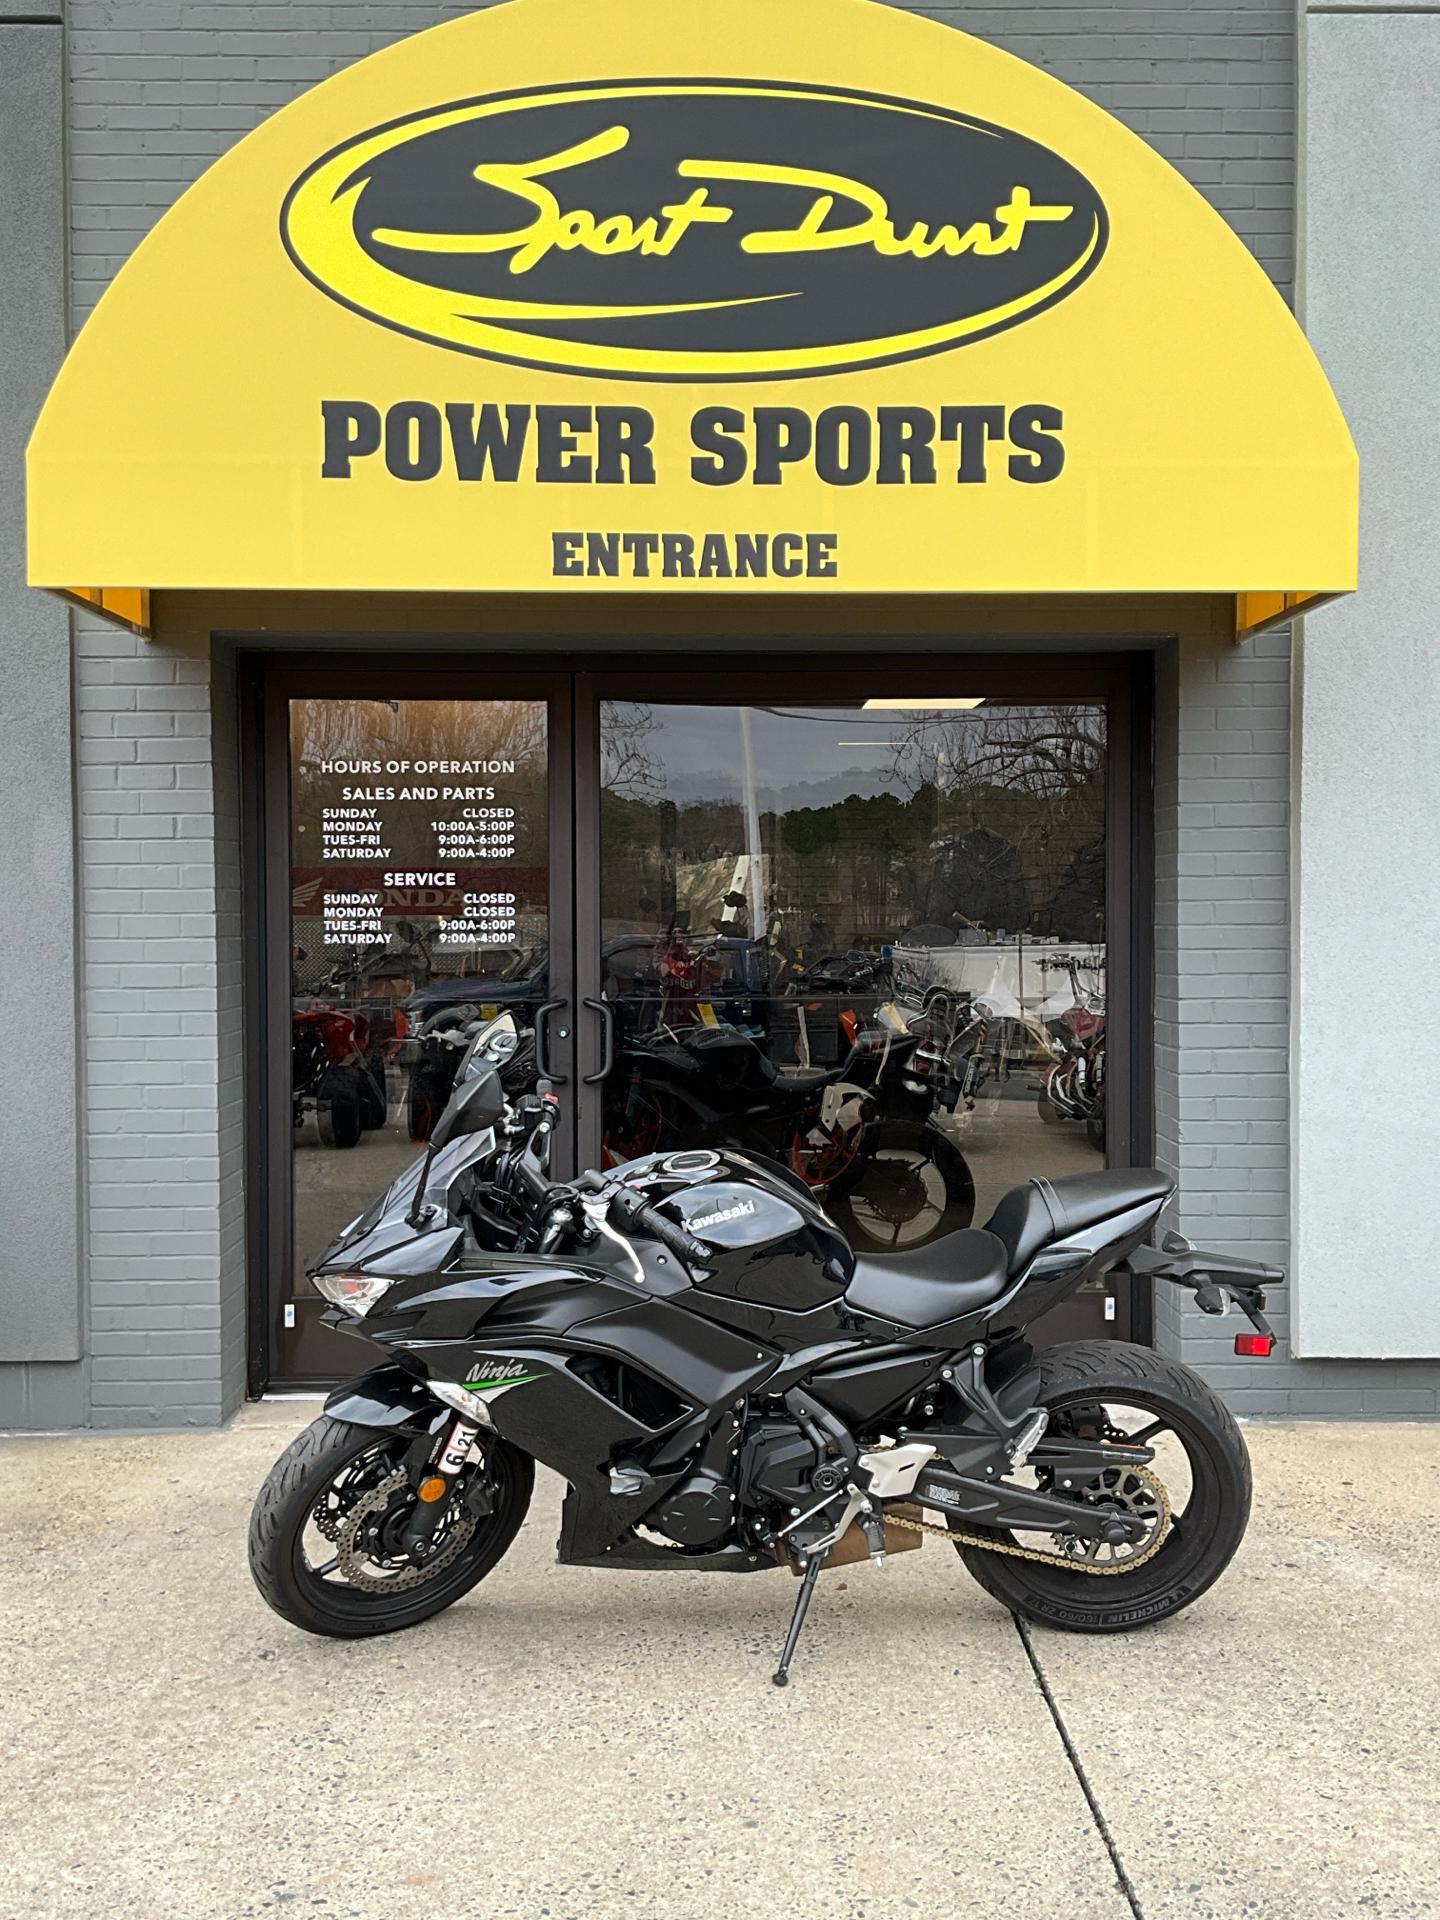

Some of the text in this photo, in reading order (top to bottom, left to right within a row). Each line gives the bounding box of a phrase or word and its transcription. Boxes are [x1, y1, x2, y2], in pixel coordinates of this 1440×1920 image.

[321, 401, 1065, 487] POWER SPORTS
[552, 532, 838, 578] ENTRANCE
[321, 760, 516, 774] HOURS OF OPERATION
[342, 786, 496, 801] SALES AND PARTS
[322, 808, 515, 819] SUNDAY CLOSED
[322, 821, 515, 832] MONDAY 10:00A-5:00P
[322, 834, 515, 845] TUES-FRI 9:00A-6:00P
[322, 848, 515, 859] SATURDAY 9:00A-4:00P
[383, 872, 456, 887] SERVICE
[323, 893, 516, 904] SUNDAY CLOSED
[323, 907, 516, 918] MONDAY CLOSED
[323, 920, 516, 931] TUES-FRI 9:00A-6:00P
[323, 933, 516, 944] SATURDAY 9:00A-4:00P
[681, 1200, 755, 1232] Kawasaki
[466, 1358, 528, 1383] Ninja
[445, 1452, 465, 1466] 6
[457, 1430, 475, 1447] 21
[1108, 1599, 1170, 1624] MICHELIN
